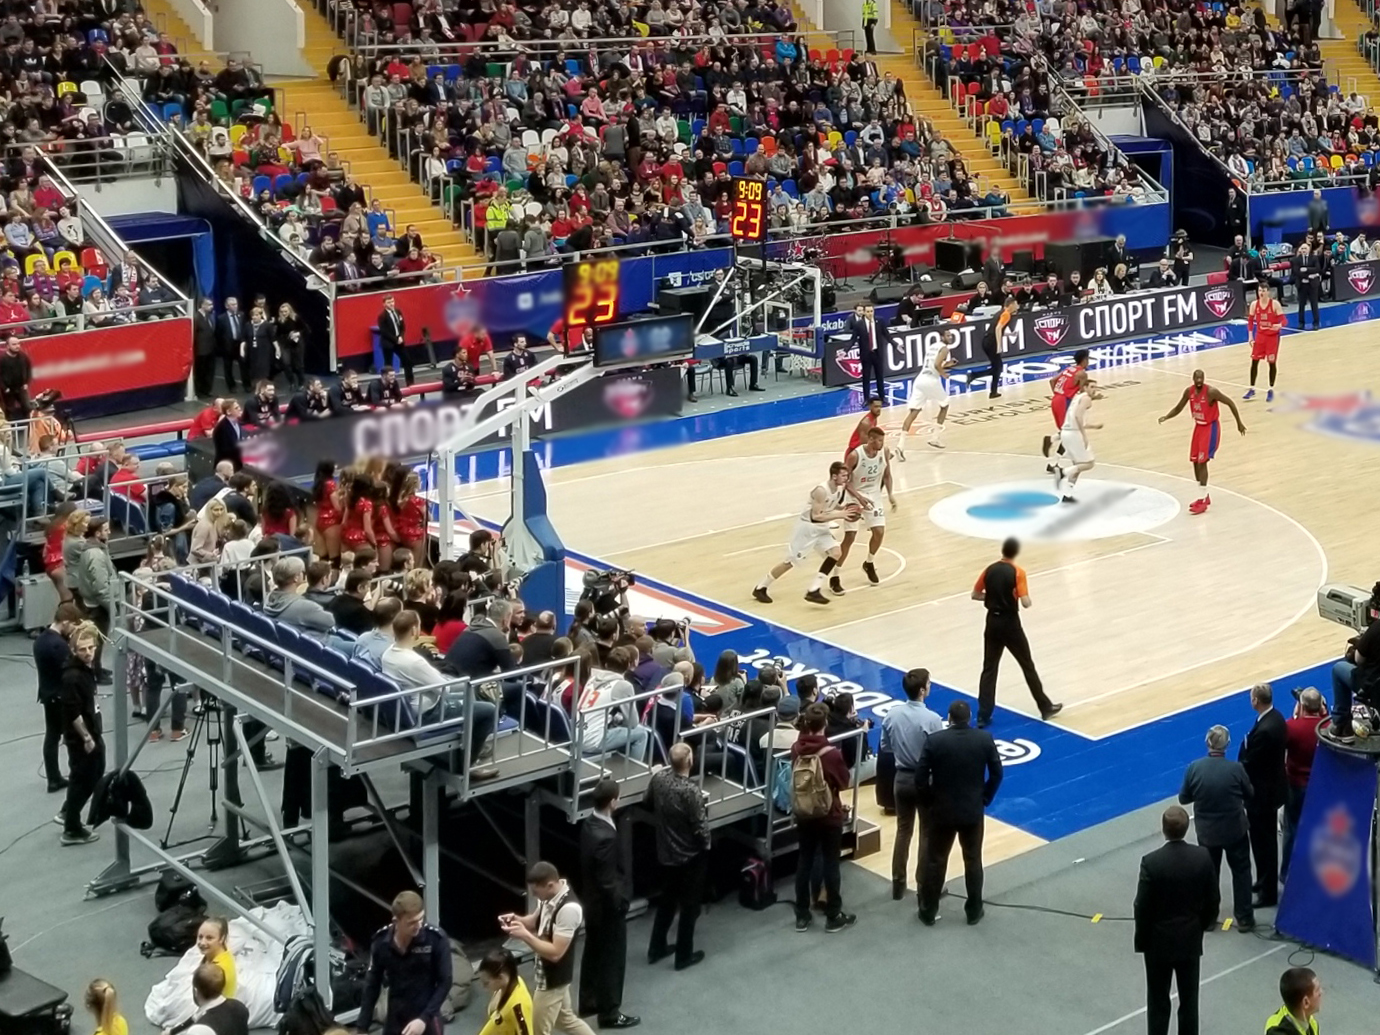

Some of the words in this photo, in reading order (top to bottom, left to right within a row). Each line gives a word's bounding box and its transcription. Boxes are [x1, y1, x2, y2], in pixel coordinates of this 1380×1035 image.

[738, 180, 763, 201] 9:09
[732, 202, 763, 239] 23
[569, 284, 616, 326] 23
[1079, 297, 1156, 340] СПОРТ
[1163, 291, 1198, 327] FM
[868, 465, 878, 474] 22
